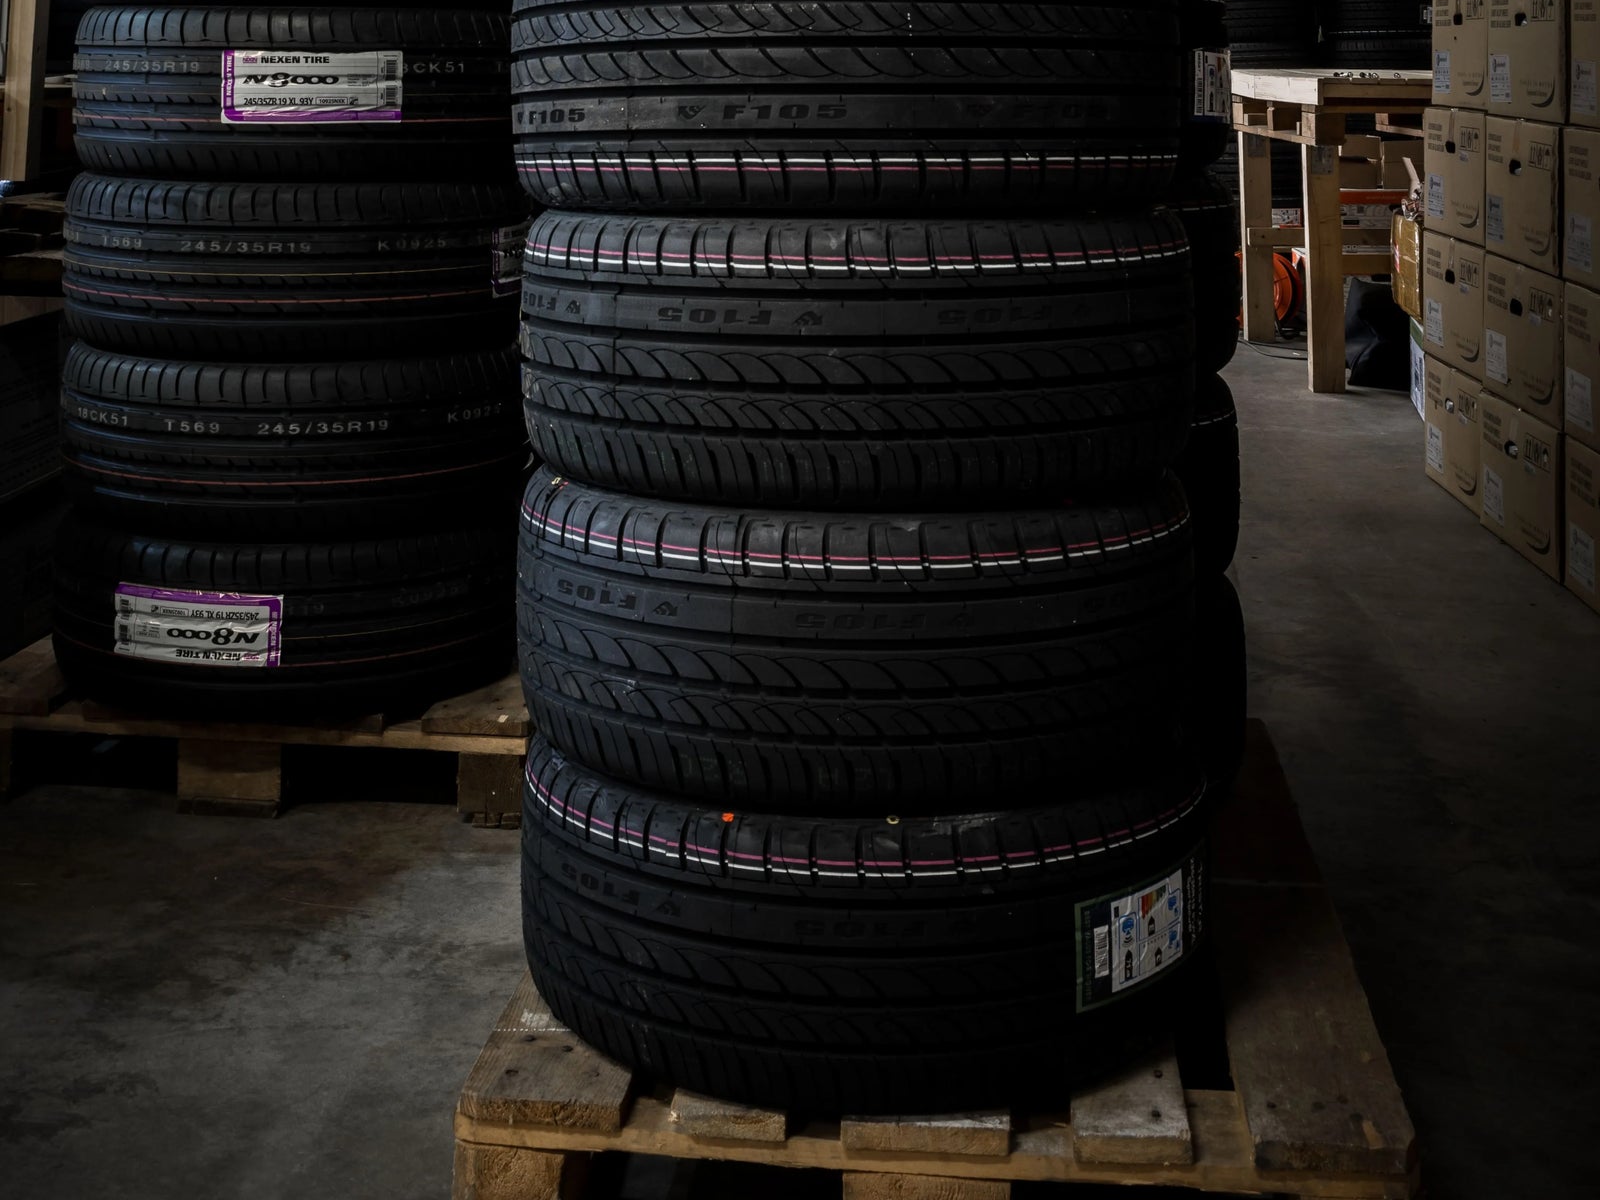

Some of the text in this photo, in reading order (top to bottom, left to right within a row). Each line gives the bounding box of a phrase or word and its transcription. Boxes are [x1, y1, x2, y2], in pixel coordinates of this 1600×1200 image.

[104, 60, 200, 72] 245/35R19
[260, 56, 300, 64] NEXEN
[303, 56, 330, 64] TIRE
[243, 72, 339, 88] N8000
[278, 98, 287, 106] 19
[288, 97, 298, 106] XL
[299, 97, 313, 106] 93Y
[529, 108, 585, 124] F105
[723, 104, 847, 119] F105
[180, 240, 311, 253] 245/35R19
[658, 307, 772, 325] F105
[77, 406, 128, 426] 18CK51
[164, 418, 220, 434] T569
[257, 419, 390, 435] 245/35R19
[558, 579, 636, 611] F105
[190, 609, 204, 618] 93Y
[795, 613, 927, 630] F105
[167, 627, 260, 645] N8000
[175, 649, 200, 659] TIRE
[560, 863, 641, 906] F105
